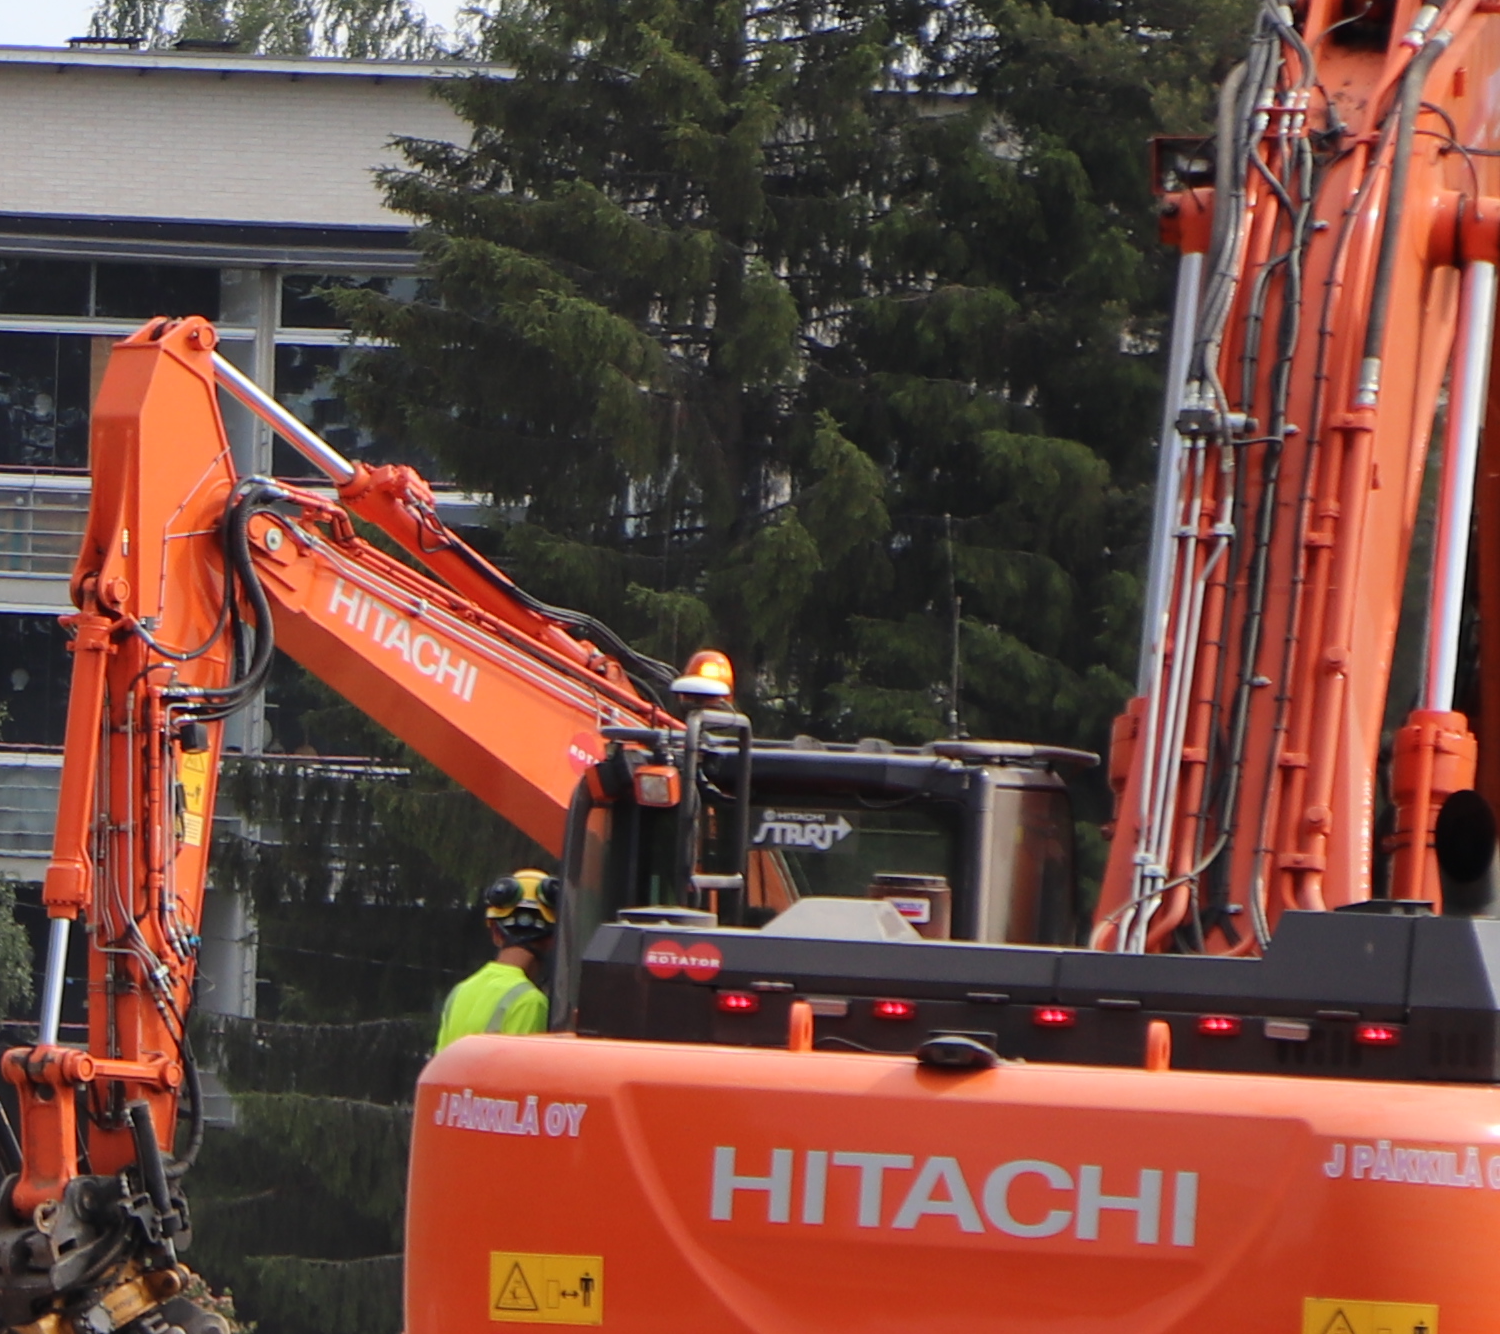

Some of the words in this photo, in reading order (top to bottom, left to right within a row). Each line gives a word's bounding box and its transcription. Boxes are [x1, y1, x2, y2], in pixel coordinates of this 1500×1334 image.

[328, 578, 479, 702] HITACHI
[646, 955, 720, 968] ROTATOR
[434, 1092, 448, 1126] J
[447, 1088, 540, 1137] PÄKKILÄ
[543, 1102, 588, 1137] OY
[1322, 1143, 1346, 1179] J
[1352, 1138, 1485, 1189] PÄKKILÄ
[709, 1145, 1199, 1248] HITACHI
